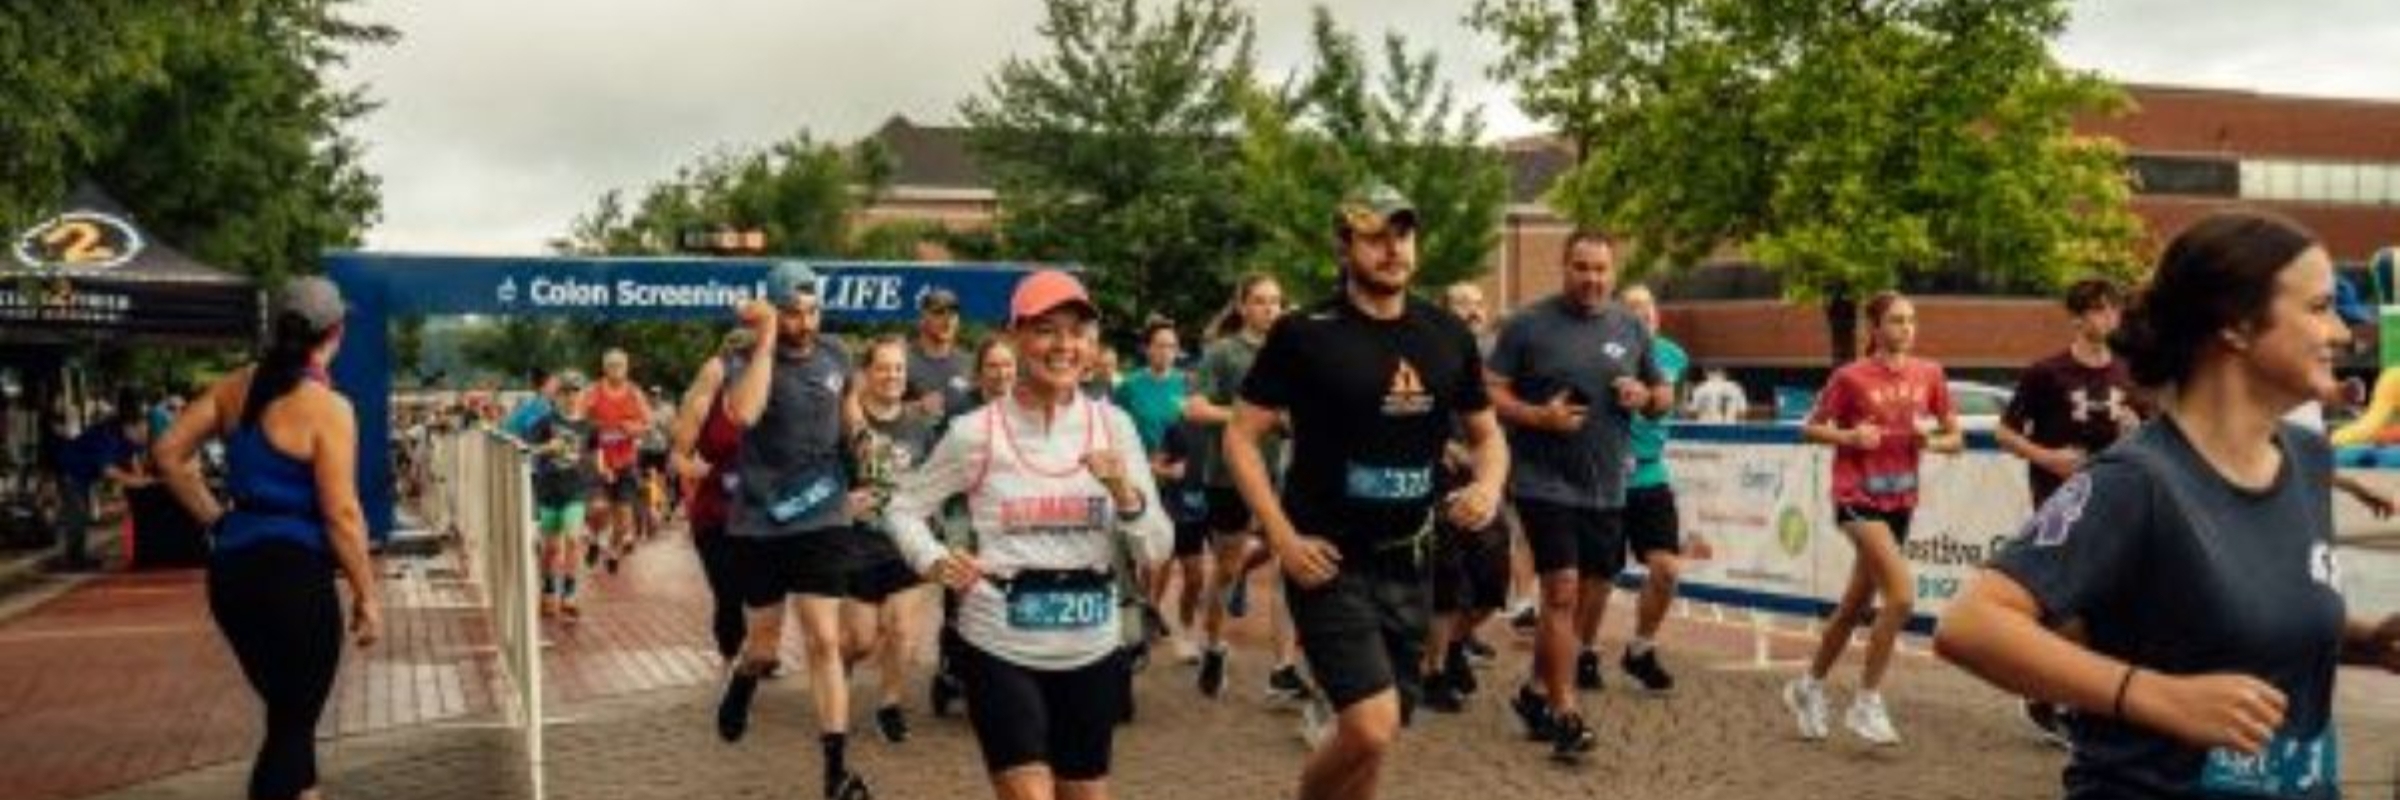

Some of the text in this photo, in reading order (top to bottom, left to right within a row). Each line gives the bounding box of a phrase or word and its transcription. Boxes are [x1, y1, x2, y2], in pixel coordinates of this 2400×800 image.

[530, 276, 610, 306] Colon
[616, 278, 751, 308] Screening
[814, 273, 903, 311] LIFE
